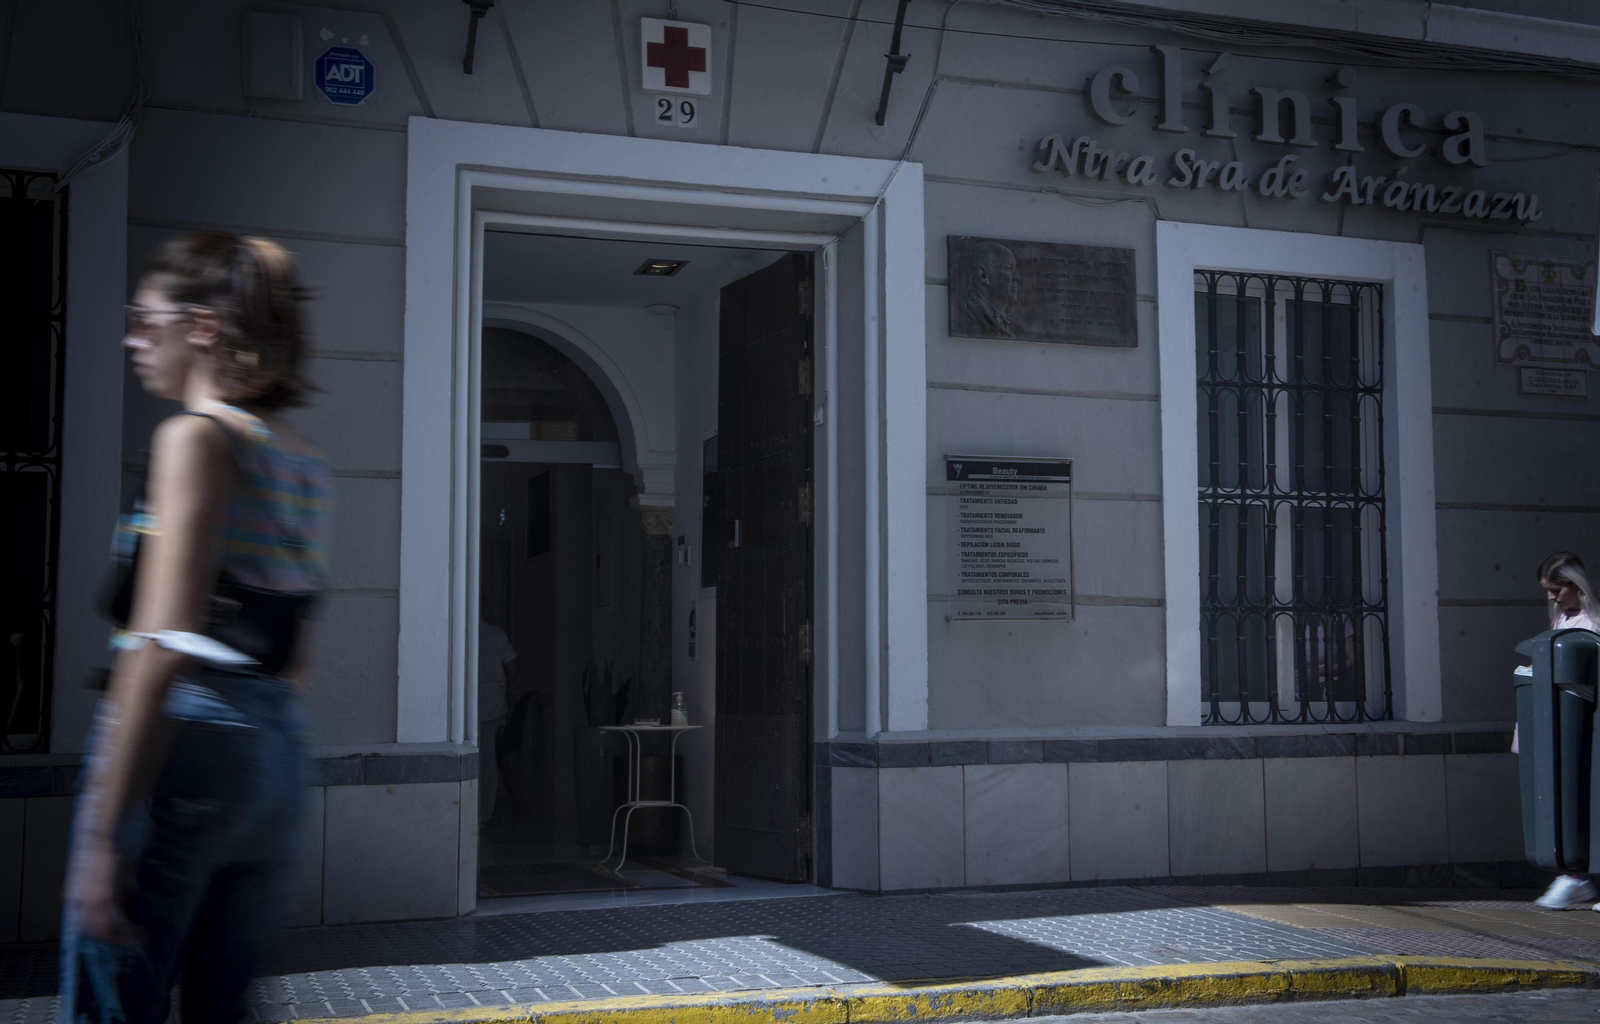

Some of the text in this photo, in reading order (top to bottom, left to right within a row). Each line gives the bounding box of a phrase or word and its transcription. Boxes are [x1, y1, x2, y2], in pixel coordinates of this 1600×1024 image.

[326, 63, 364, 83] ADT
[658, 98, 695, 124] 29
[1088, 44, 1492, 166] clínica
[1031, 133, 1543, 222] Ntra Sra de Aránzazu
[992, 467, 1018, 476] Beauty
